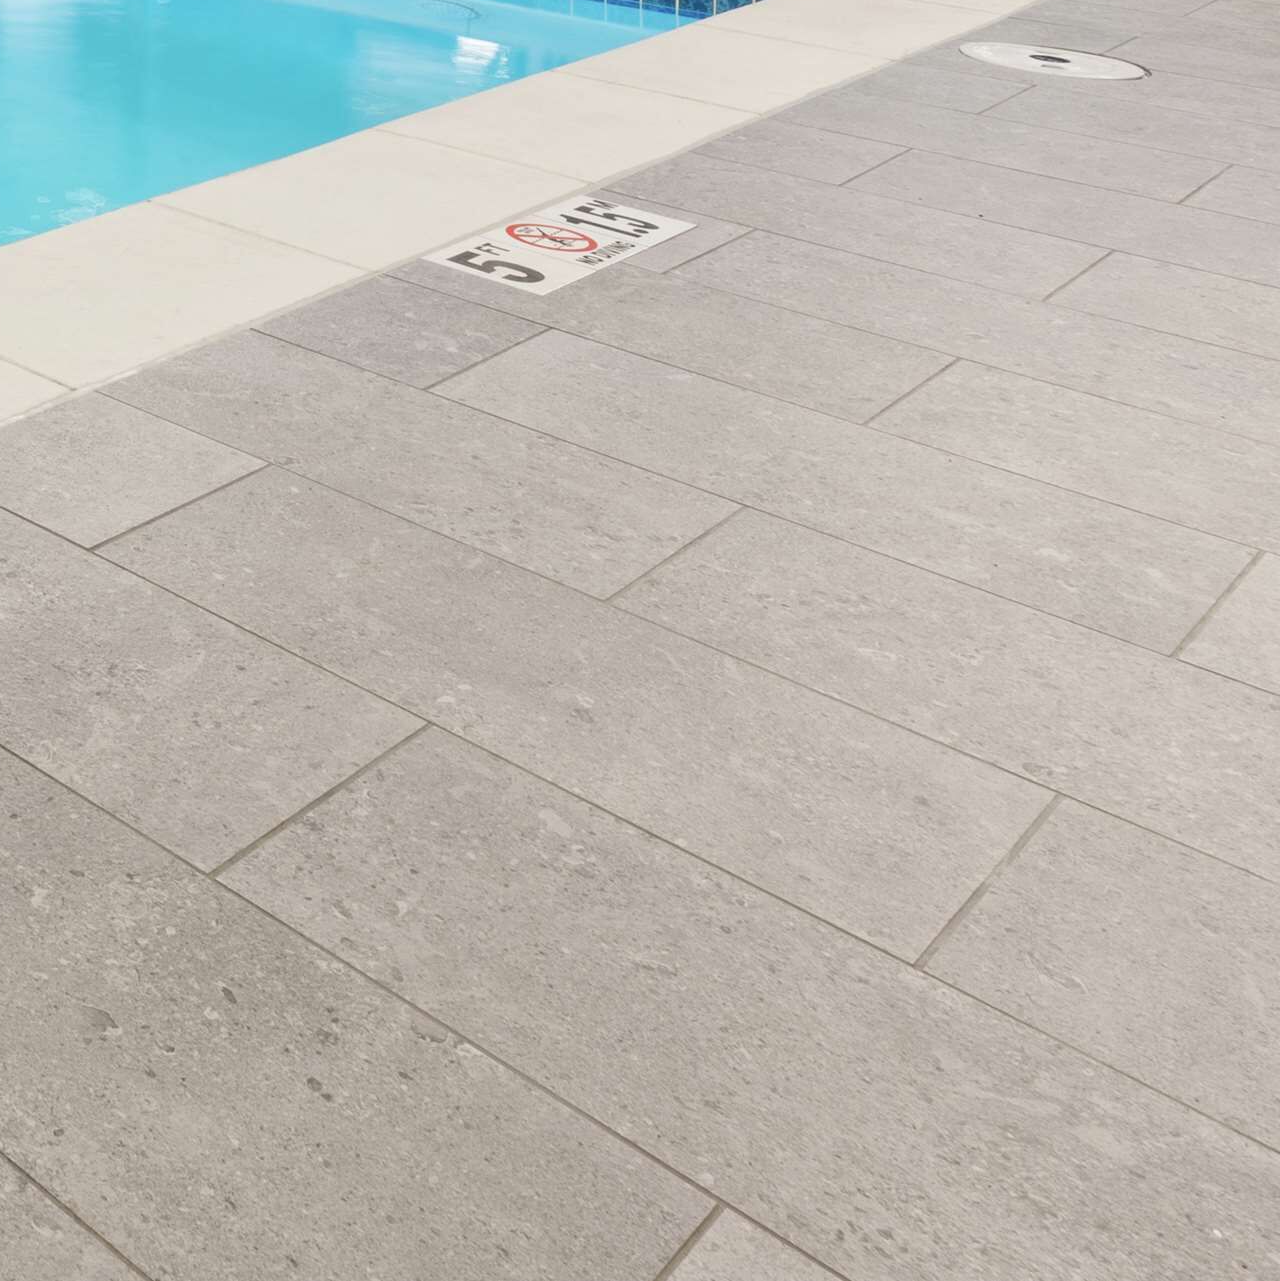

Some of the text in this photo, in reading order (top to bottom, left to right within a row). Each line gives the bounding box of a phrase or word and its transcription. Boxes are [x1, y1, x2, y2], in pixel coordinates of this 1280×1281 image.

[559, 205, 659, 239] 1.5
[446, 242, 545, 283] 5 FT
[576, 254, 604, 266] NO
